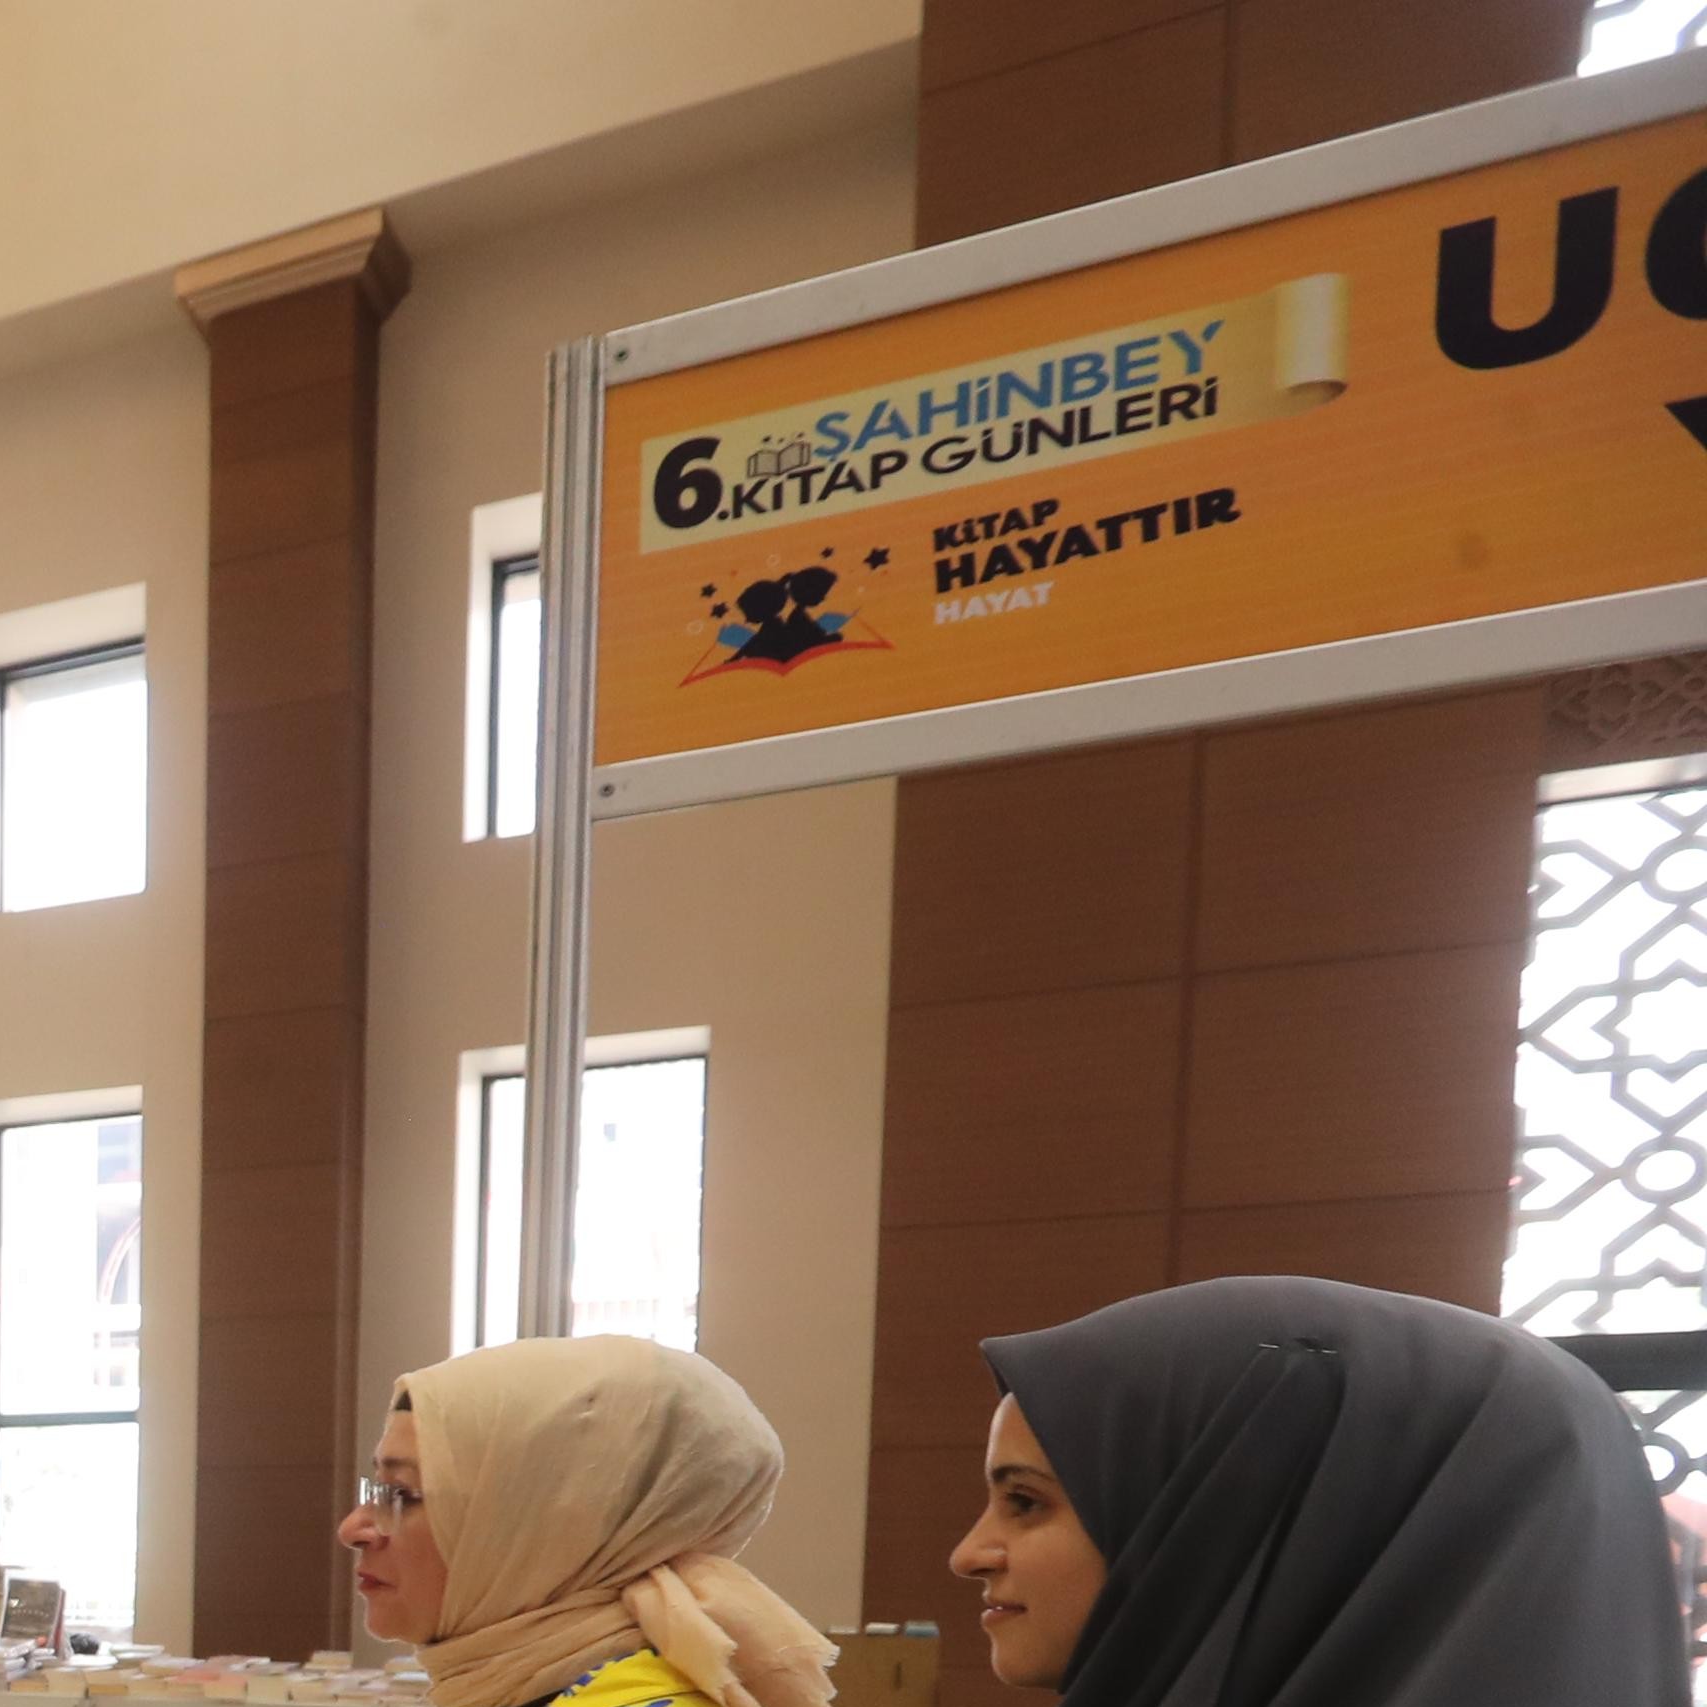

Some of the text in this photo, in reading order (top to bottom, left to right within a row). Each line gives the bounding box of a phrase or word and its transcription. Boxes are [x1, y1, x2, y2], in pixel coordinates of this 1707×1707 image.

[814, 320, 1225, 461] ŞAHİNBEY
[733, 377, 1218, 521] KİTAP GÜNLERİ
[934, 499, 1059, 553] KİTAP
[935, 488, 1242, 593] HAYATTIR
[935, 582, 1054, 624] HAYAT
